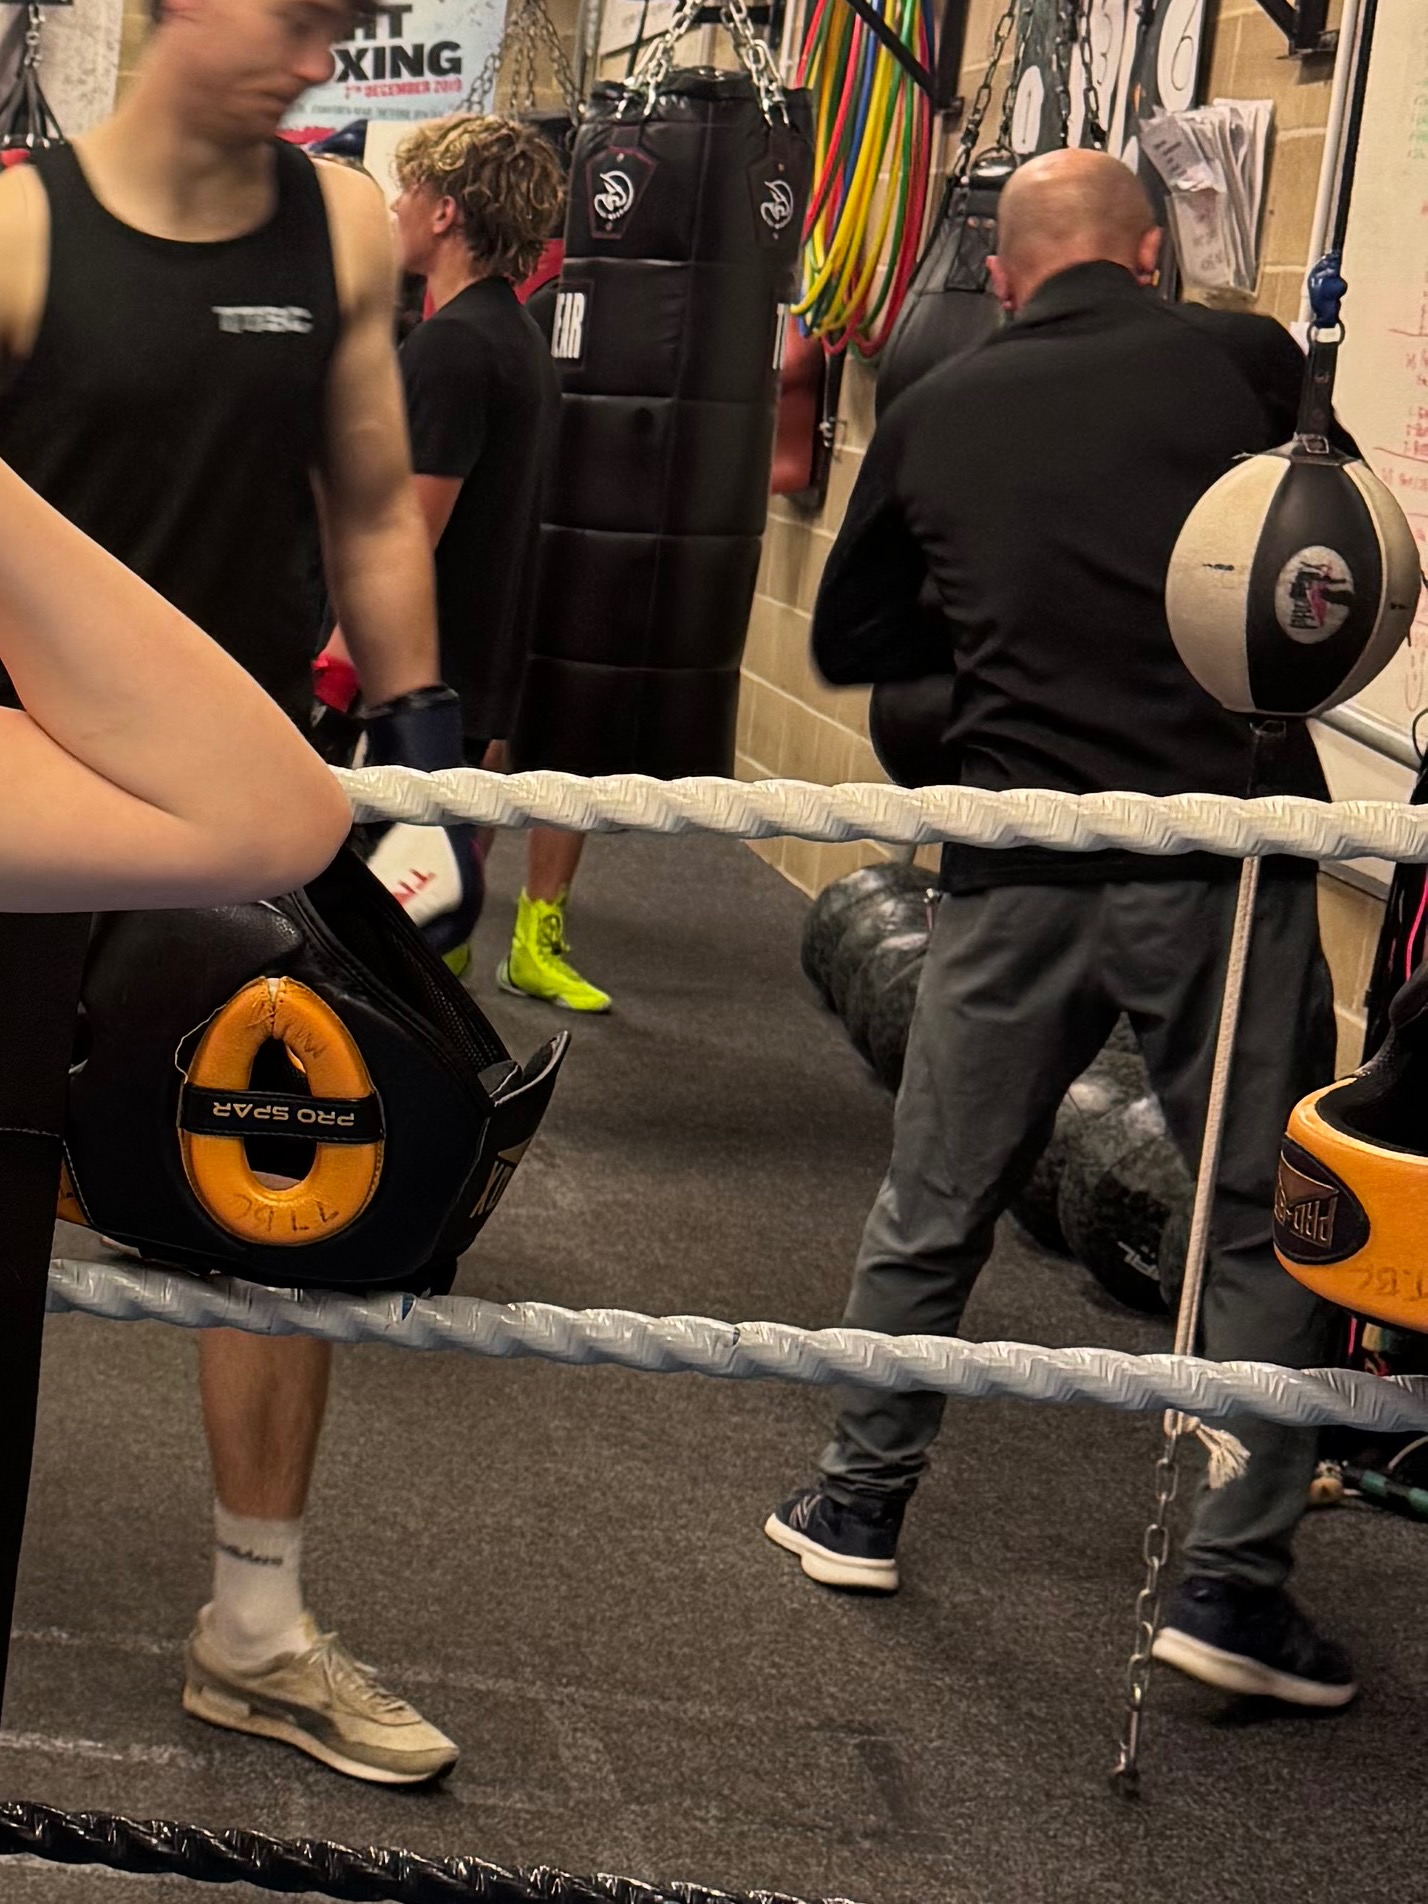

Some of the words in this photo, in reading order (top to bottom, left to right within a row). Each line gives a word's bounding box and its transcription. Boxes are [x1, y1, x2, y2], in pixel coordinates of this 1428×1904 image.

[334, 41, 463, 83] XING
[212, 1101, 290, 1121] SPAR
[296, 1107, 356, 1127] PRO
